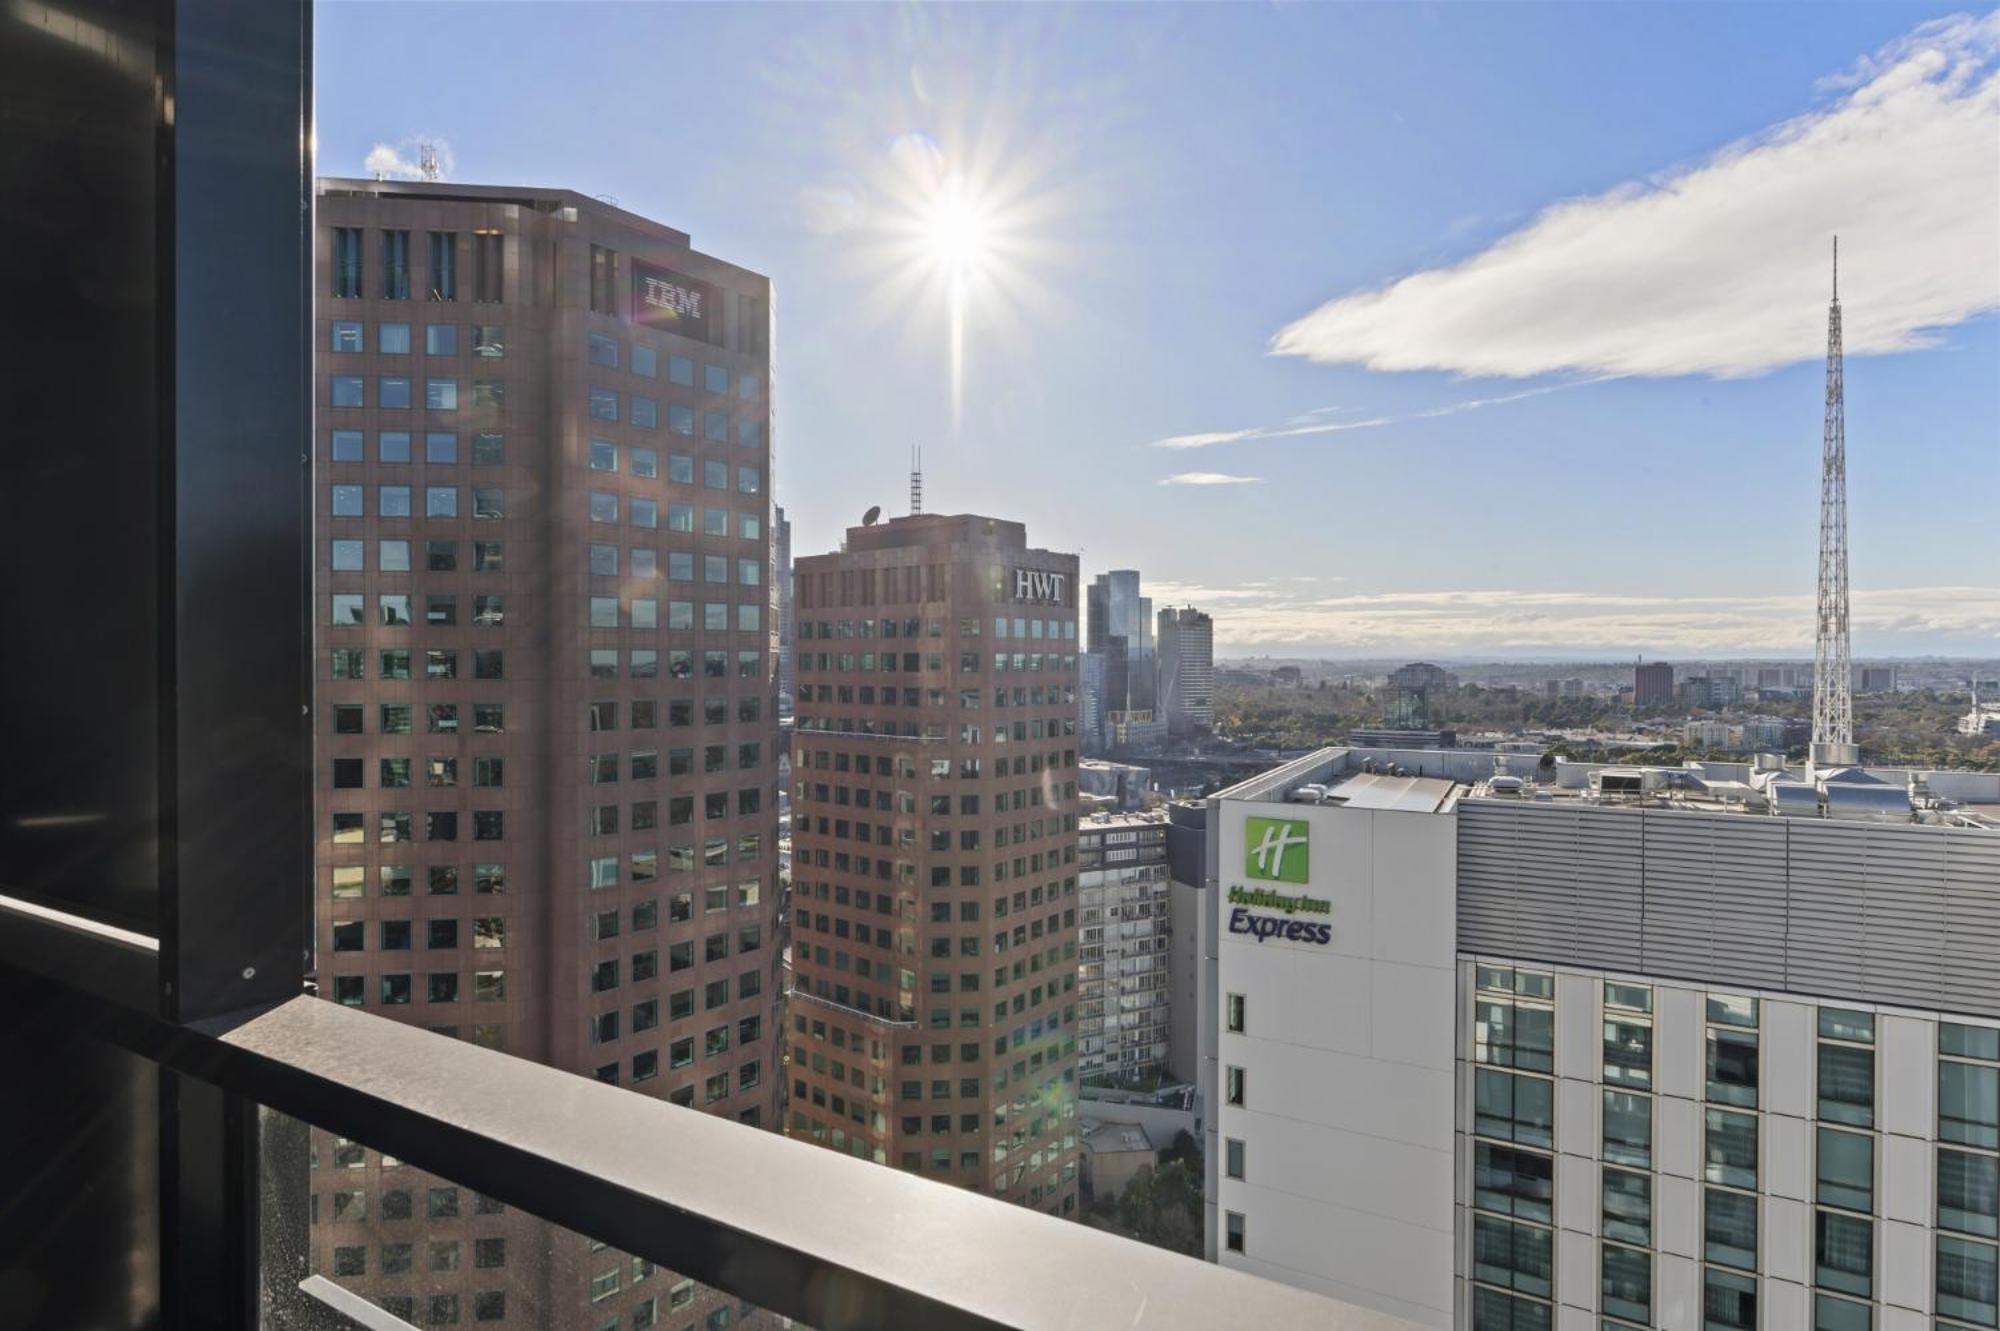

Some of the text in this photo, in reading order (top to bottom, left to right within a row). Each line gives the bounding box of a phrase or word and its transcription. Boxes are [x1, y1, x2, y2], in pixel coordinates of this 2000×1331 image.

[645, 277, 701, 319] IBM
[1016, 568, 1065, 601] HWT
[1227, 885, 1297, 914] Holiday
[1229, 907, 1332, 945] Express
